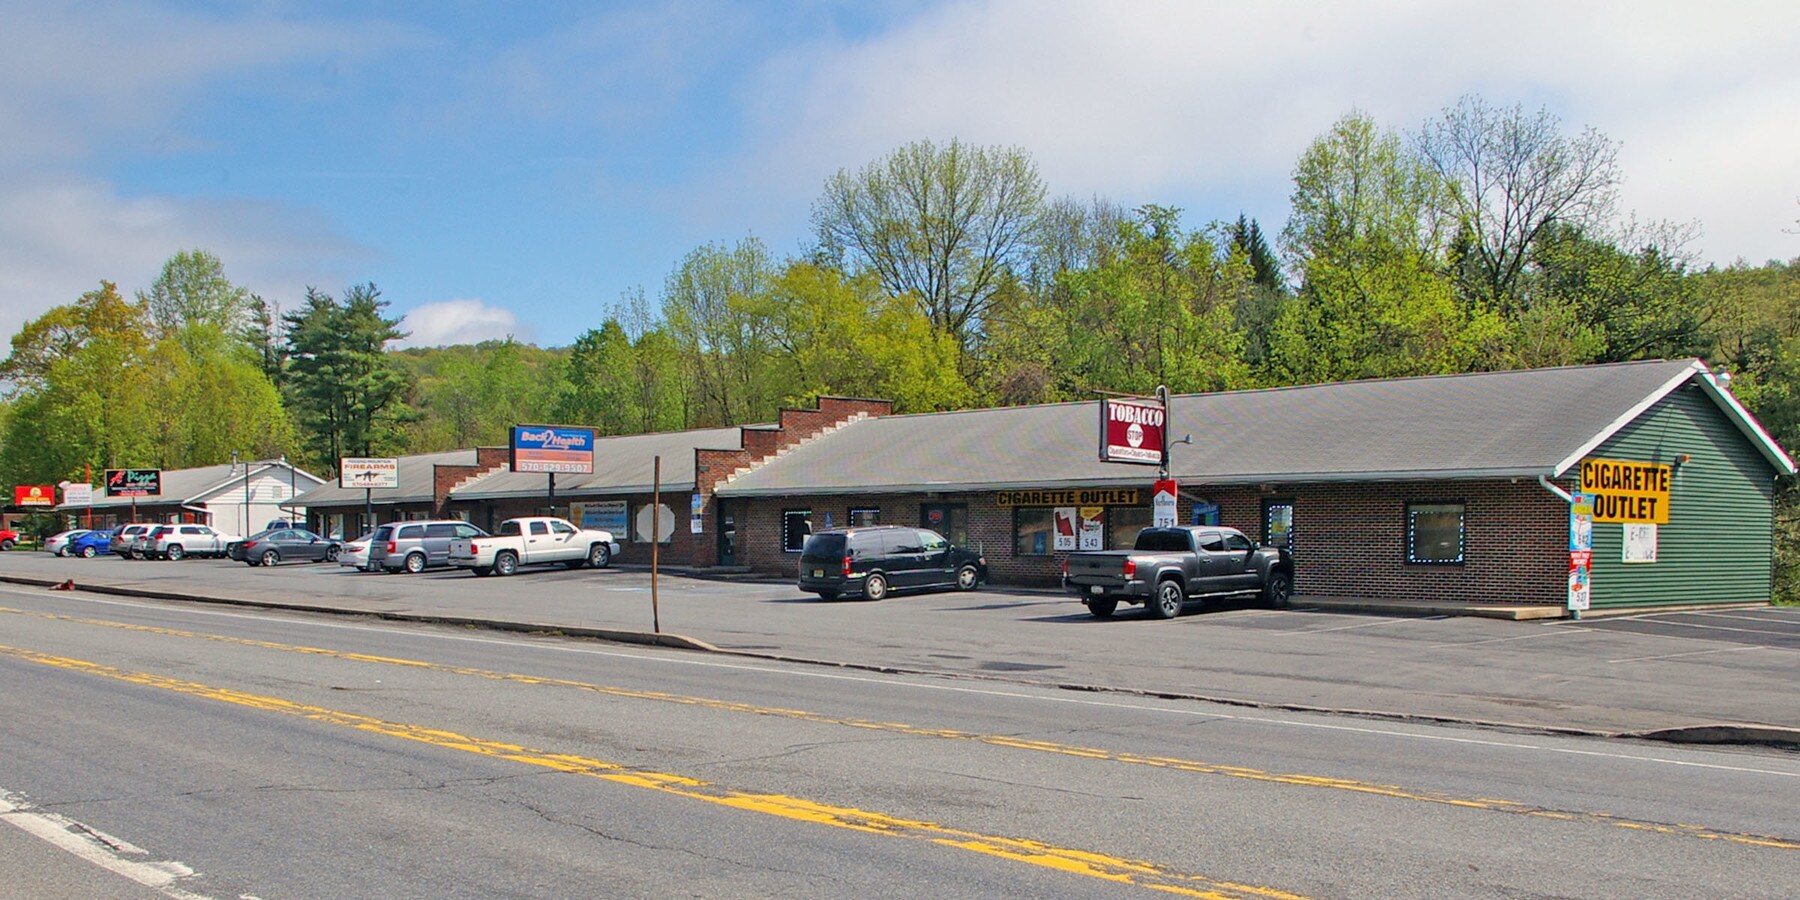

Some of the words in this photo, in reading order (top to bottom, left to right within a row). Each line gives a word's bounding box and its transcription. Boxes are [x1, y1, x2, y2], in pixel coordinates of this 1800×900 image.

[1108, 403, 1164, 428] TOBACCO
[1128, 429, 1143, 441] STOP
[127, 470, 157, 484] Pizza
[1583, 462, 1668, 492] CIGARETTE
[998, 491, 1075, 505] CIGARETTE
[1080, 490, 1136, 504] OUTLET
[1593, 494, 1657, 519] OUTLET
